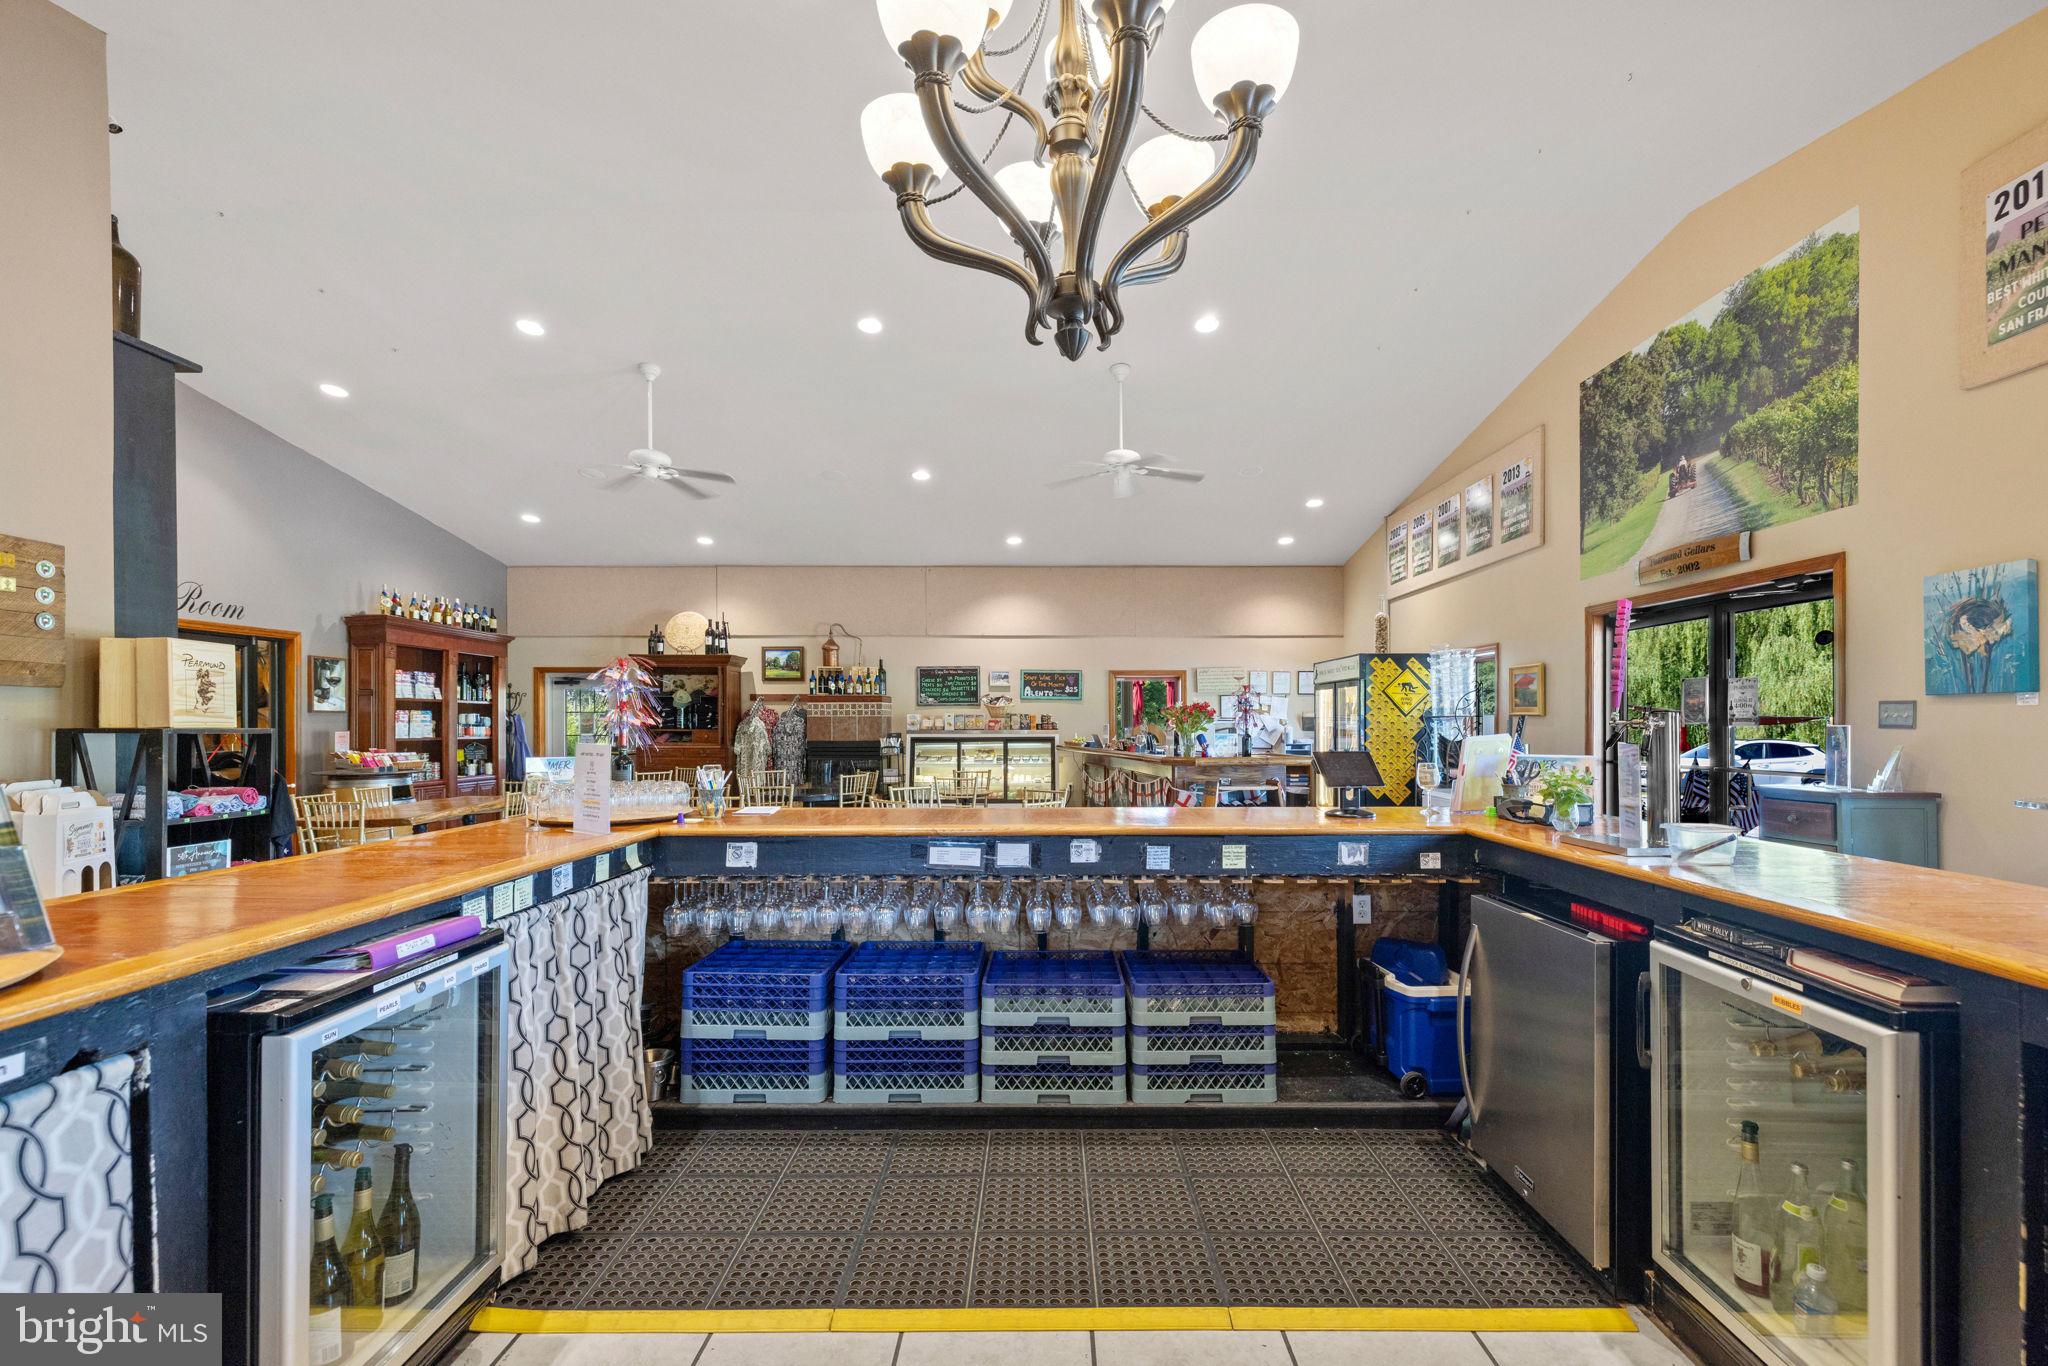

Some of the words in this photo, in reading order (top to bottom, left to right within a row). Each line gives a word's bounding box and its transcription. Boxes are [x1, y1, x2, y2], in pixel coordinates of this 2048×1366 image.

[1999, 241, 2048, 276] MAN
[1987, 280, 2018, 304] BEST
[2018, 286, 2048, 308] COU
[1998, 315, 2024, 336] SAN
[1502, 464, 1520, 486] 2013
[1438, 500, 1451, 518] 2007
[1413, 513, 1426, 530] 2005
[1684, 543, 1716, 558] Cellars
[1677, 560, 1700, 575] 2002
[178, 582, 245, 620] Room
[182, 654, 226, 670] PEARMUND
[1697, 921, 1711, 932] WINE
[1712, 926, 1729, 936] FOLLY
[379, 1001, 398, 1013] PEARLS
